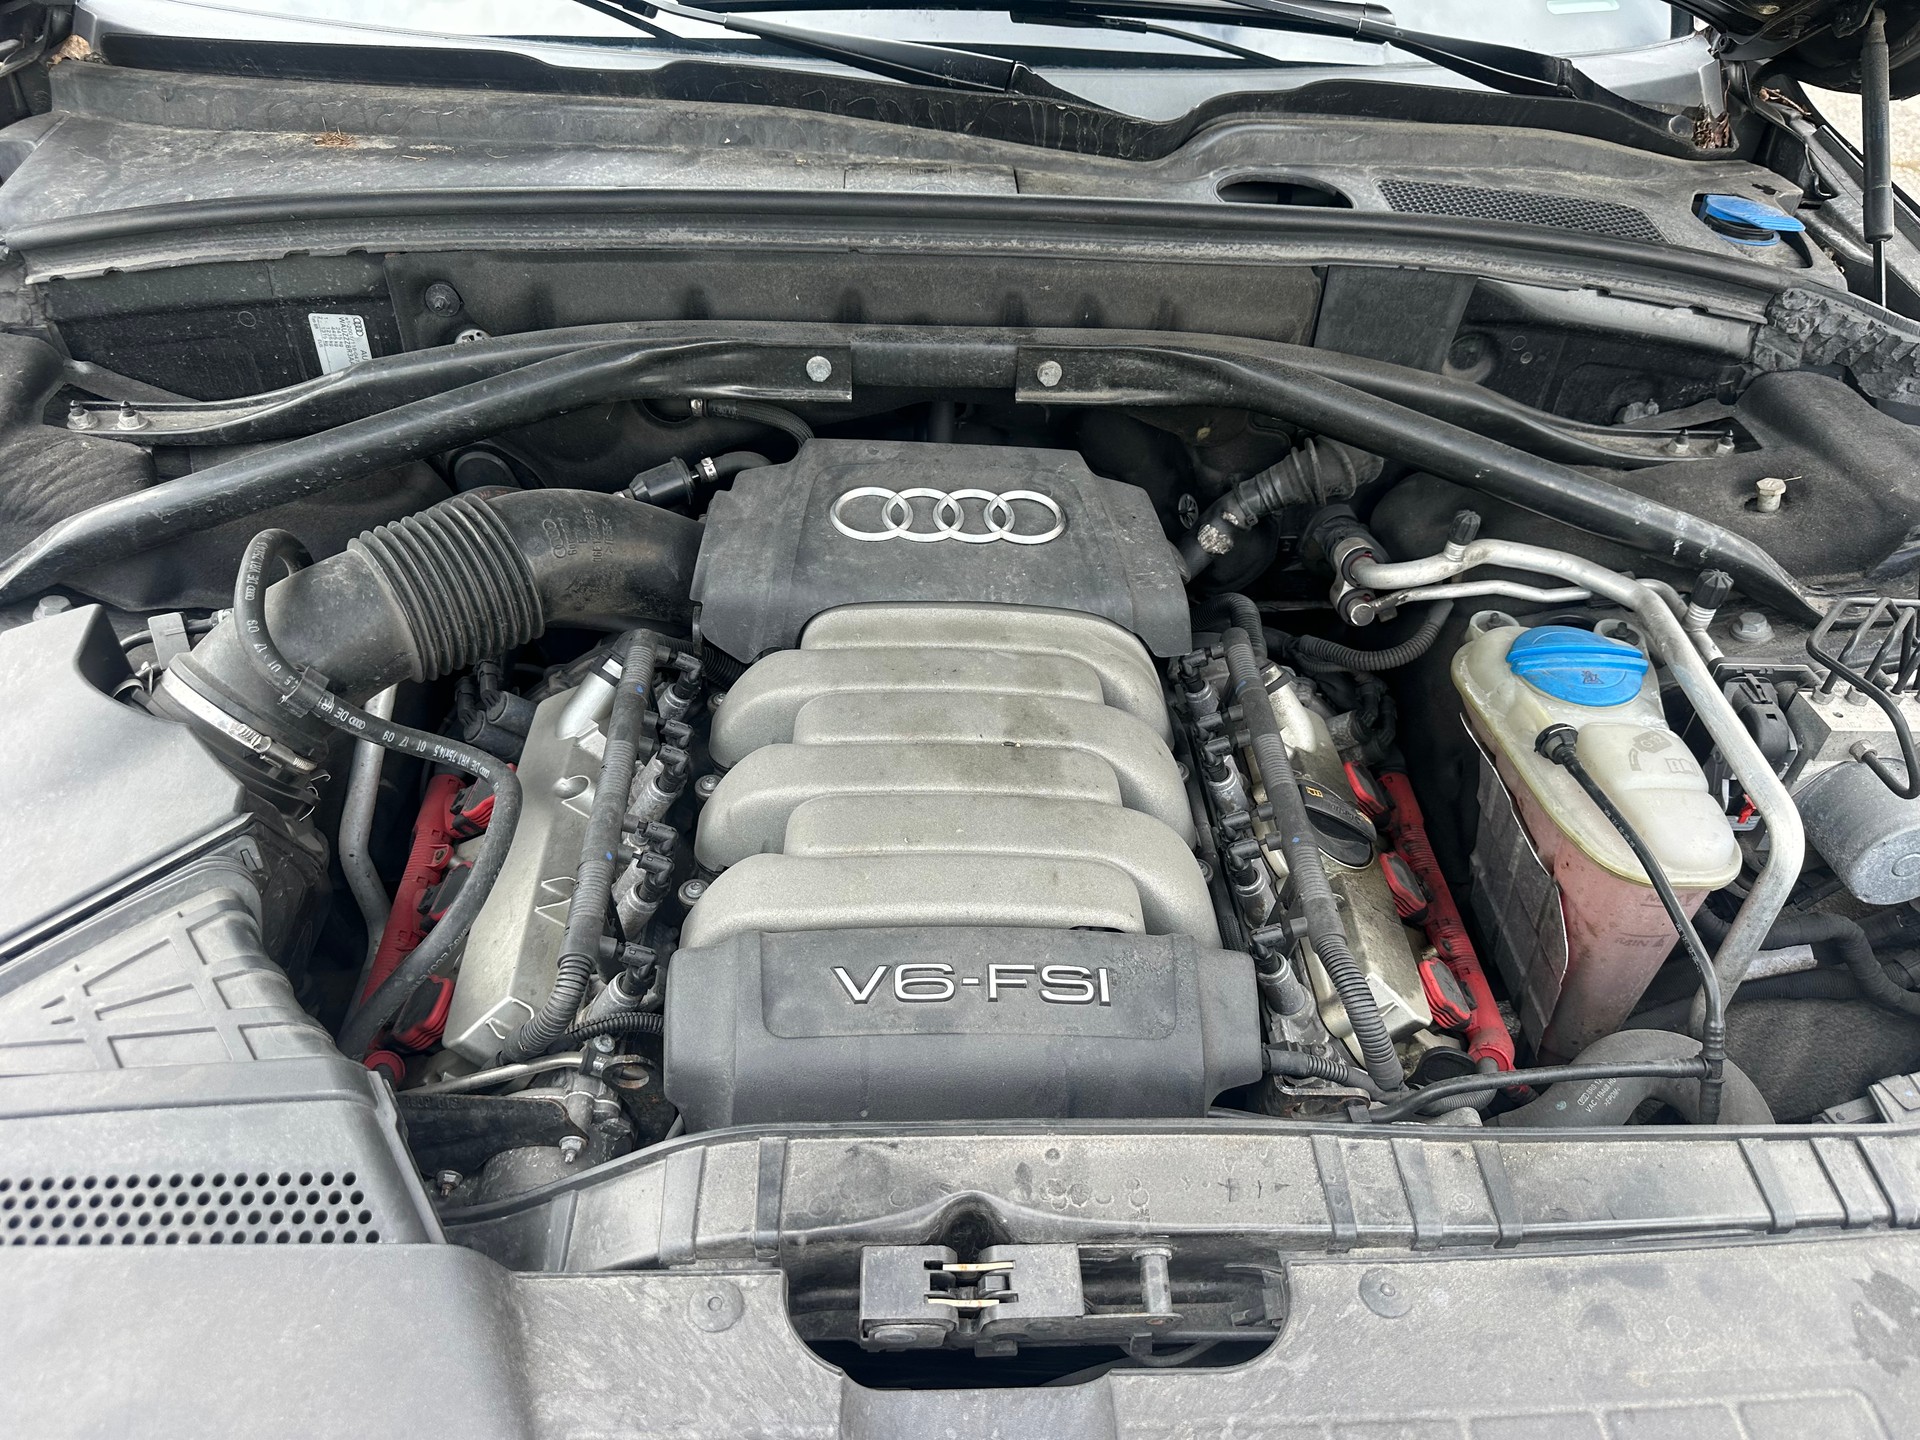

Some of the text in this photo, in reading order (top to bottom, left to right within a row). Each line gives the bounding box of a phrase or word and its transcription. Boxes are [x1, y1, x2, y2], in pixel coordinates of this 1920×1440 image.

[249, 574, 260, 585] DE
[333, 706, 350, 722] DE
[382, 730, 395, 743] 09
[398, 735, 410, 747] 17
[415, 740, 427, 752] 01
[470, 760, 480, 773] DE
[830, 962, 1112, 1007] V6-FSI
[1585, 1100, 1597, 1112] VAC
